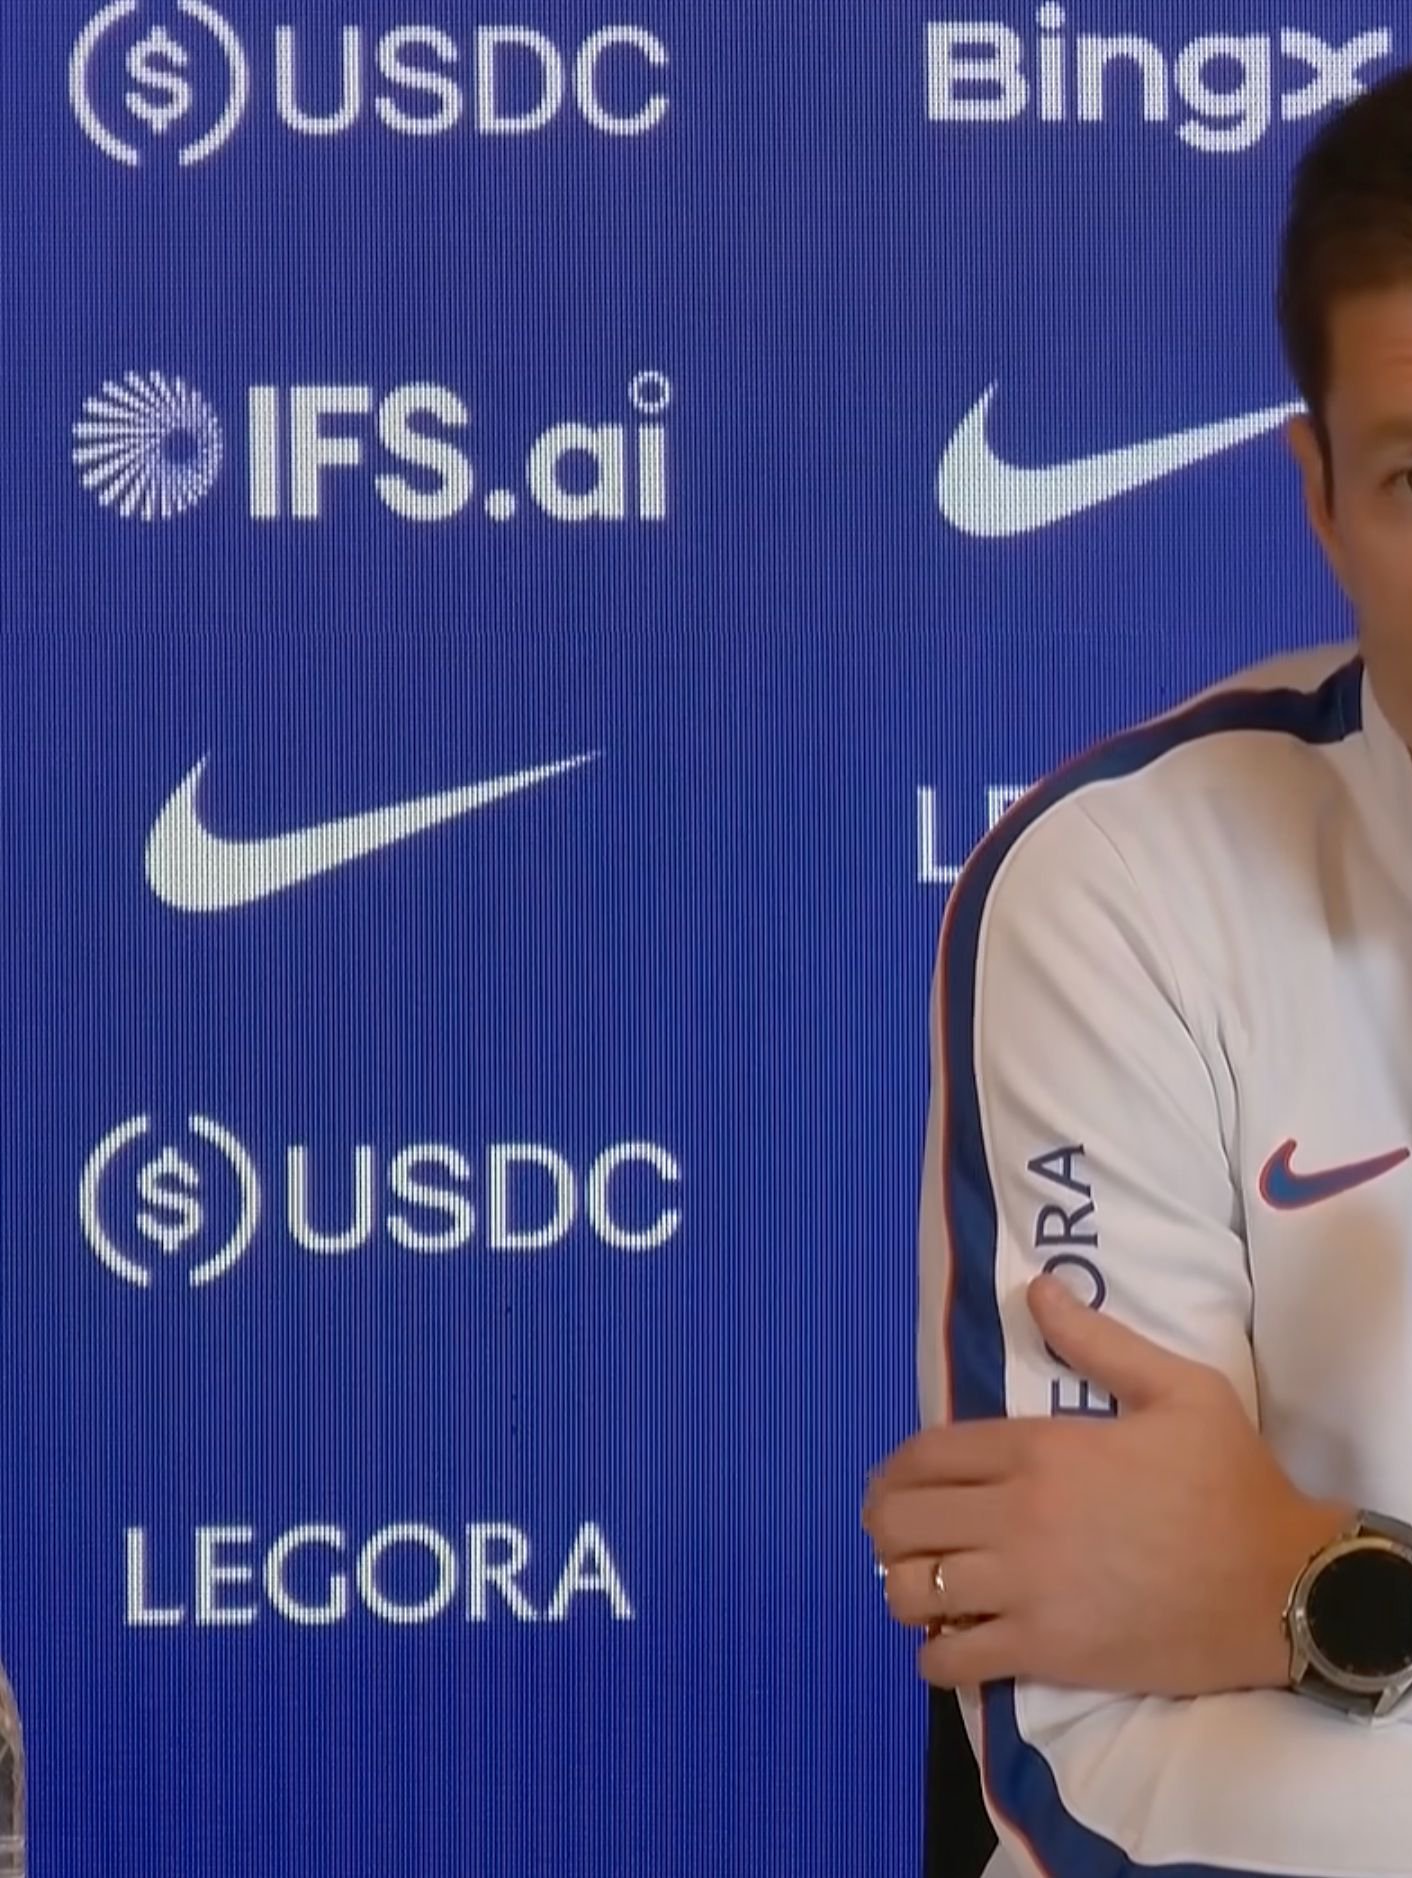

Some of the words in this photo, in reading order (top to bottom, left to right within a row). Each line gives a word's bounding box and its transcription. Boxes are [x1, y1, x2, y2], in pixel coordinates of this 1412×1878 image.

[275, 24, 670, 137] USDC
[248, 371, 672, 521] IFS.ai
[286, 1140, 683, 1254] USDC
[124, 1521, 637, 1626] LEGORA
